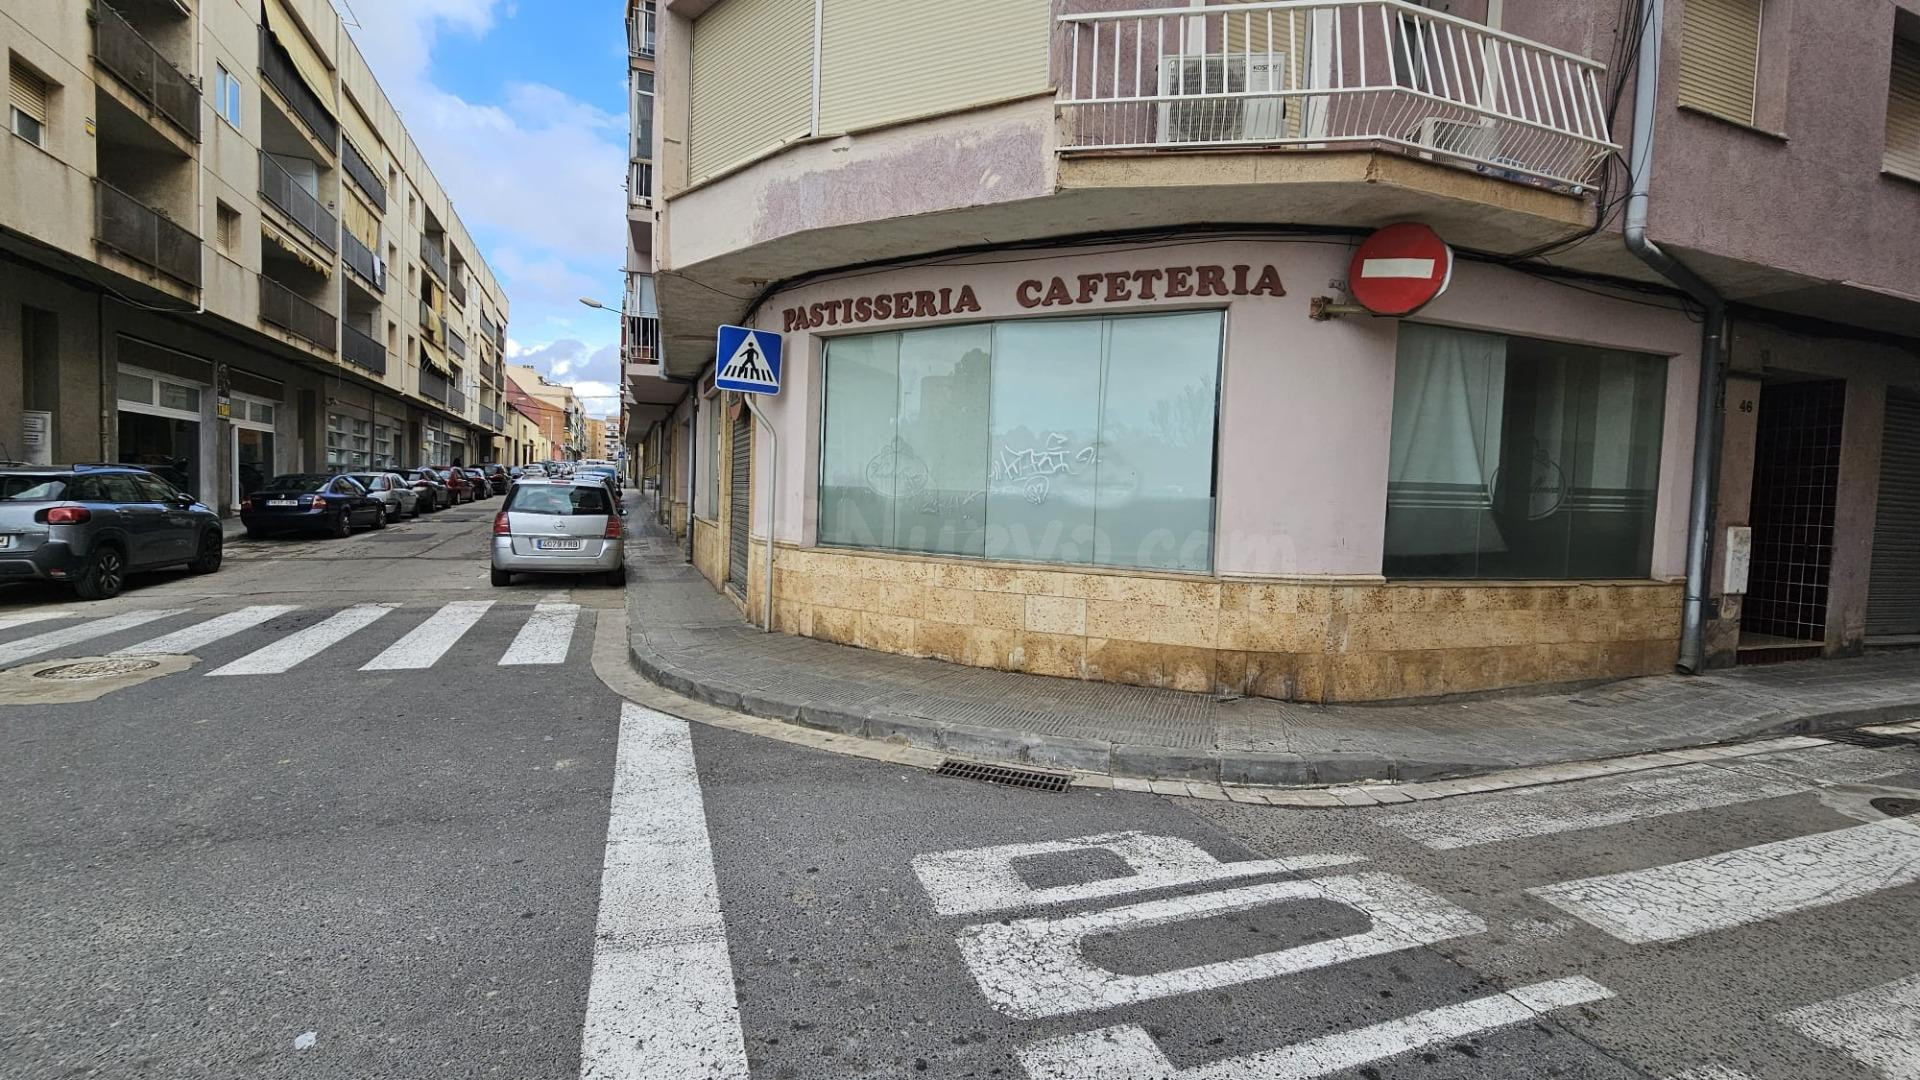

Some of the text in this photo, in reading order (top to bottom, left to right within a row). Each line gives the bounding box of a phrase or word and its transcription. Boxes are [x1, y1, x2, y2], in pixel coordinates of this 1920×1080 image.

[783, 264, 1287, 333] PASTISSERIA CAFETERIA
[1738, 400, 1753, 413] 46
